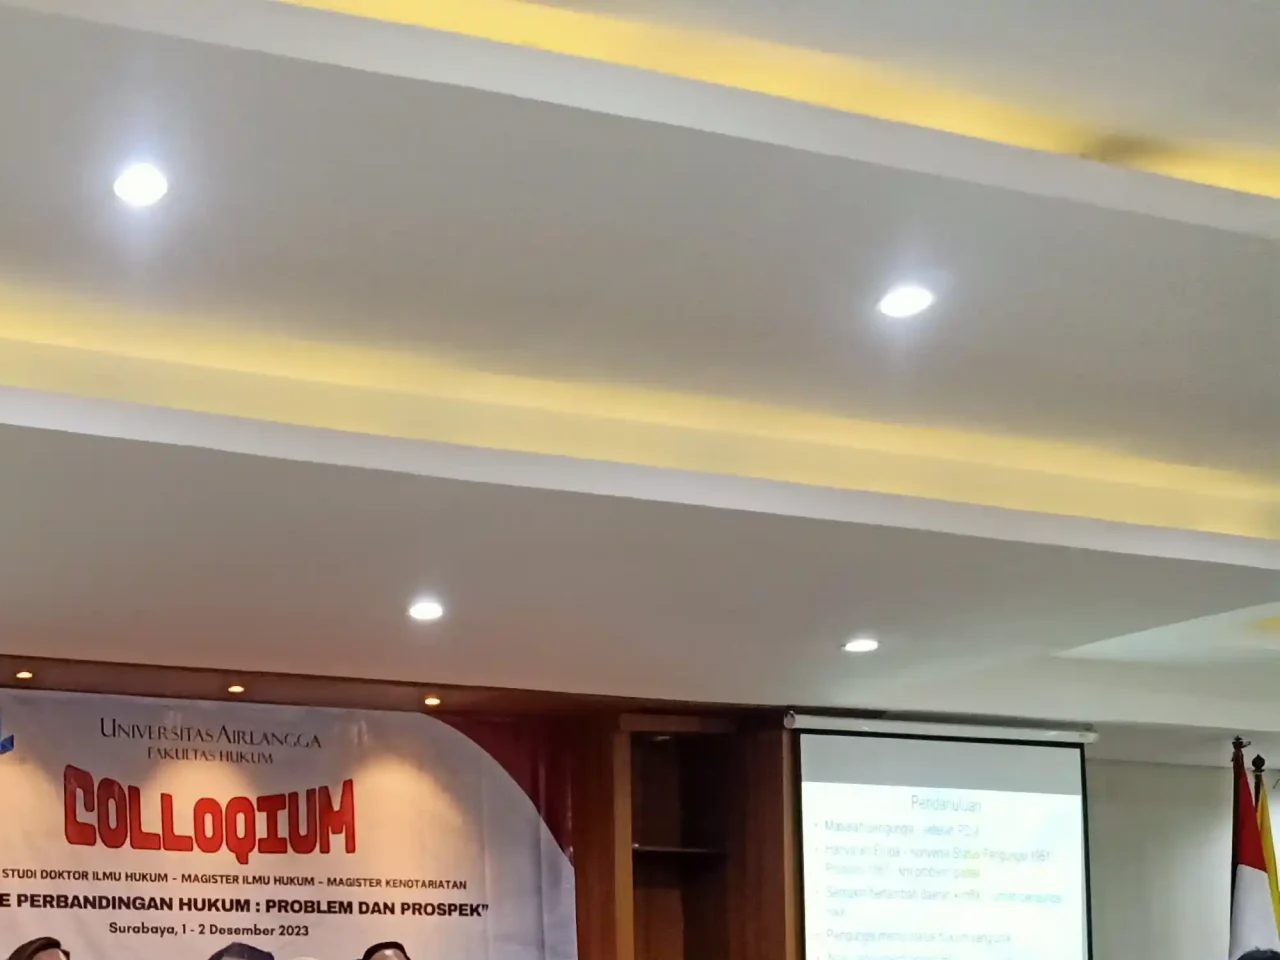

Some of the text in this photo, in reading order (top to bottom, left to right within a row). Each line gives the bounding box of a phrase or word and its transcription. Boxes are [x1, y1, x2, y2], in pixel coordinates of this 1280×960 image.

[100, 717, 322, 749] UNIVERSITAS AIRLANGGA
[148, 746, 274, 765] FAKULTAS HUKUM
[63, 764, 356, 865] COLLOQIUM
[2, 868, 37, 879] STUDI
[40, 869, 88, 881] DOKTOR
[92, 871, 121, 881] ILMU
[125, 872, 168, 883] HUKUM
[181, 873, 239, 884] MAGISTER
[242, 875, 270, 885] ILMU
[274, 876, 315, 886] HUKUM
[327, 877, 382, 888] MAGISTER
[385, 878, 467, 889] KENOTARIATAN
[17, 893, 173, 911] PERBANDINGAN
[179, 897, 251, 912] HUKUM
[255, 901, 261, 912] :
[265, 899, 353, 915] PROBLEM
[358, 901, 395, 915] DAN
[109, 922, 178, 937] Surabaya,
[198, 924, 206, 935] 2
[210, 924, 276, 936] Desember
[279, 925, 309, 936] 2023
